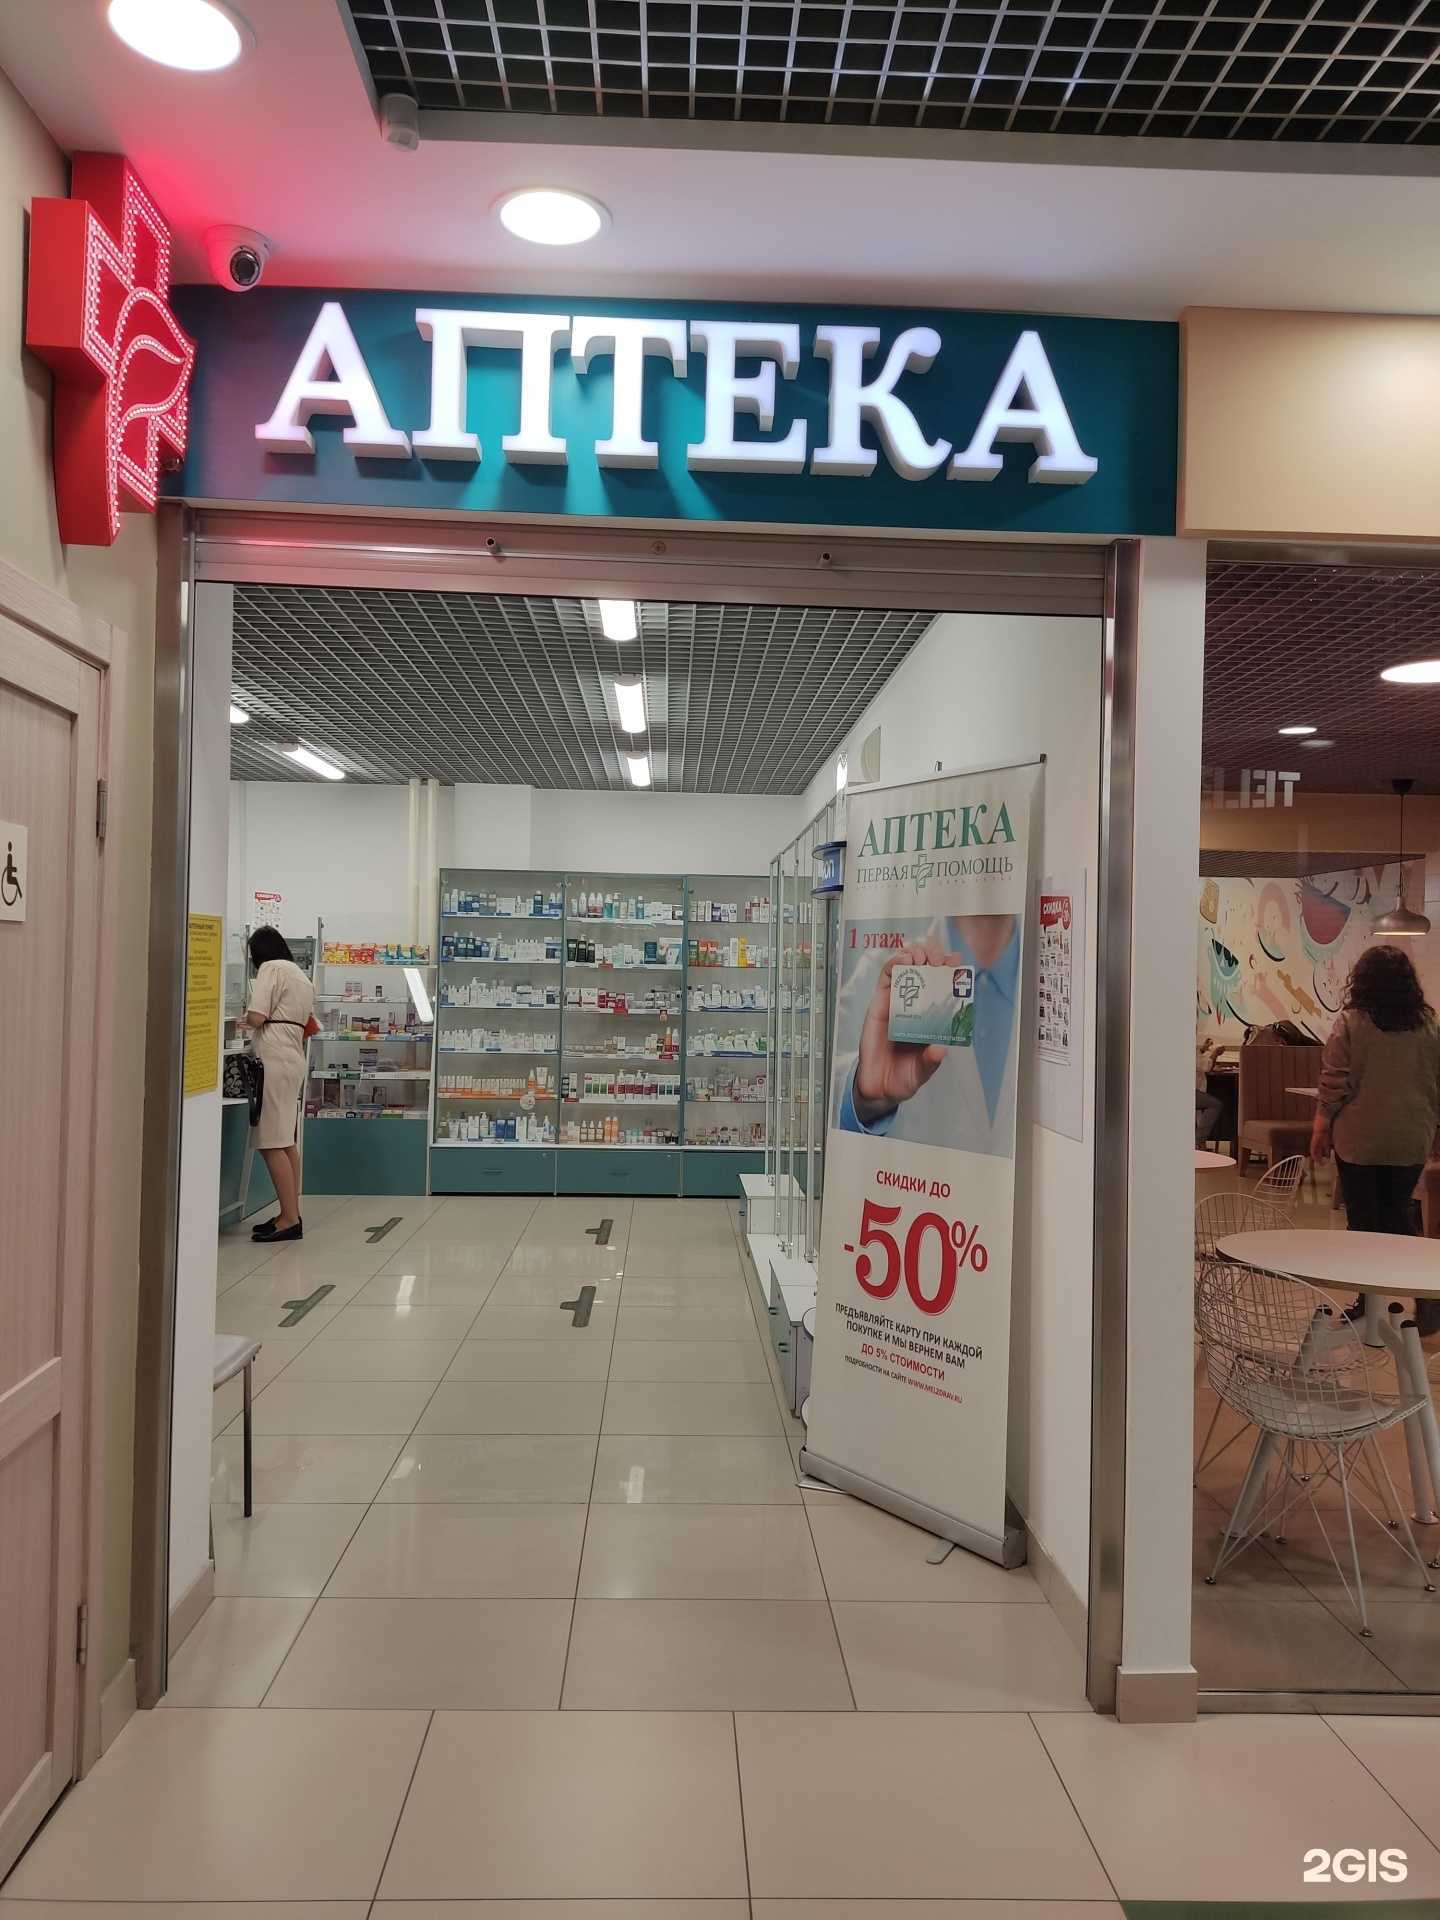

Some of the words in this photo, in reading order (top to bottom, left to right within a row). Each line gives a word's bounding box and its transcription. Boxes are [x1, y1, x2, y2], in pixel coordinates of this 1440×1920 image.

[255, 302, 1098, 485] АПТЕКА
[857, 802, 1016, 857] АПТЕКА
[856, 865, 908, 883] ПЕРВАЯ
[937, 857, 1013, 877] ПОМОЩЬ
[850, 928, 857, 948] 1
[863, 932, 904, 949] этаж
[876, 1170, 926, 1194] СКИДКИ
[929, 1181, 951, 1198] ДО
[844, 1198, 988, 1316] -50%
[835, 1302, 894, 1331] ПРЕДЪЯВЛЯЙТЕ
[895, 1322, 921, 1339] КАРТУ
[923, 1331, 941, 1345] ПРИ
[942, 1337, 983, 1360] КАЖДОЙ
[846, 1320, 882, 1341] ПОКУПКЕ
[884, 1332, 890, 1343] И
[892, 1334, 907, 1348] МЫ
[909, 1341, 944, 1362] ВЕРНЕМ
[945, 1354, 965, 1369] ВАМ
[844, 1355, 882, 1375] ПОДРОБНОСТИ
[890, 1370, 907, 1383] САЙТЕ
[861, 1343, 874, 1356] ДО
[876, 1348, 888, 1360] 5%
[889, 1353, 945, 1381] СТОИМОСТИ
